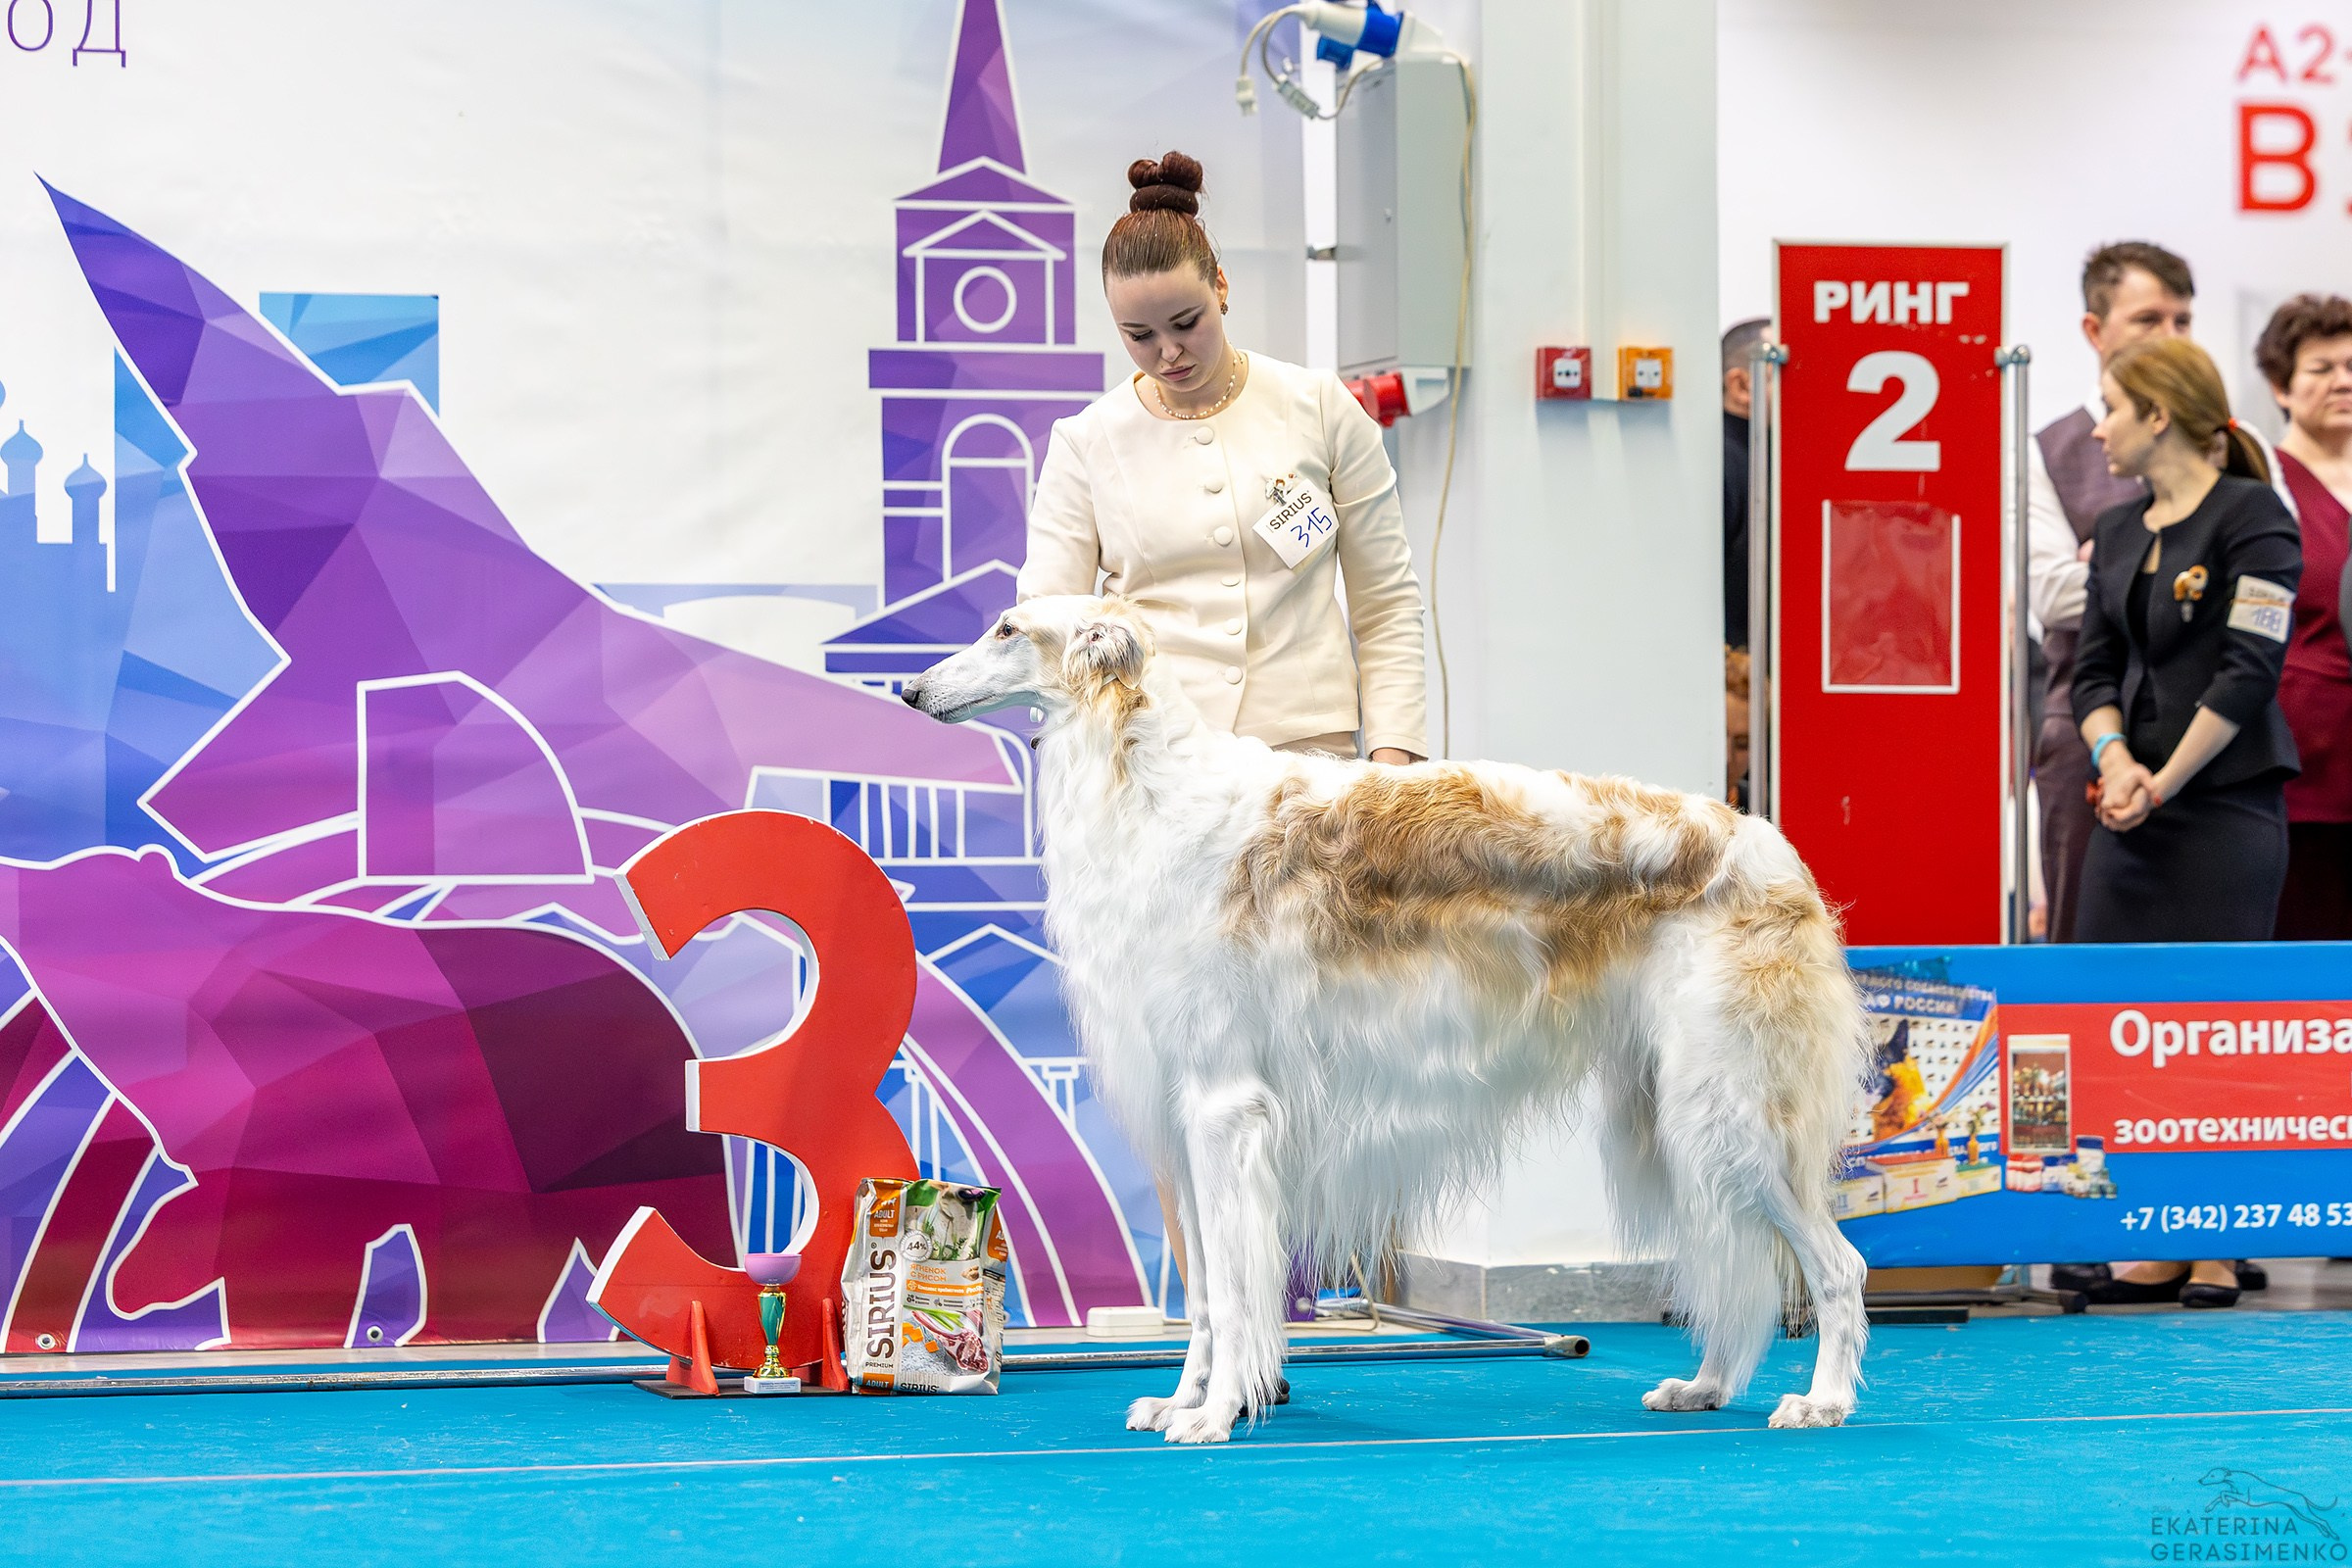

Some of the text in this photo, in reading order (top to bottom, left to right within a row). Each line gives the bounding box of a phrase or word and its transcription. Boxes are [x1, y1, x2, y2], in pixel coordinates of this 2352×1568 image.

[1814, 280, 1970, 324] РИНГ
[1844, 350, 1940, 471] 2
[1269, 491, 1312, 530] SIRIUS
[1290, 507, 1333, 548] 315
[2110, 1009, 2352, 1068] Организа
[586, 808, 918, 1372] 3
[2114, 1115, 2352, 1144] зоотехничес
[874, 1209, 895, 1219] ADULT
[2120, 1206, 2154, 1230] +7
[2161, 1204, 2228, 1233] (342)
[2233, 1203, 2282, 1229] 237
[2287, 1202, 2321, 1227] 48
[906, 1241, 927, 1251] 44%
[909, 1263, 947, 1275] ЯГНЕНОК
[917, 1272, 947, 1282] РИСОМ
[866, 1250, 897, 1358] SIRIUS
[900, 1382, 938, 1394] SIRIUS
